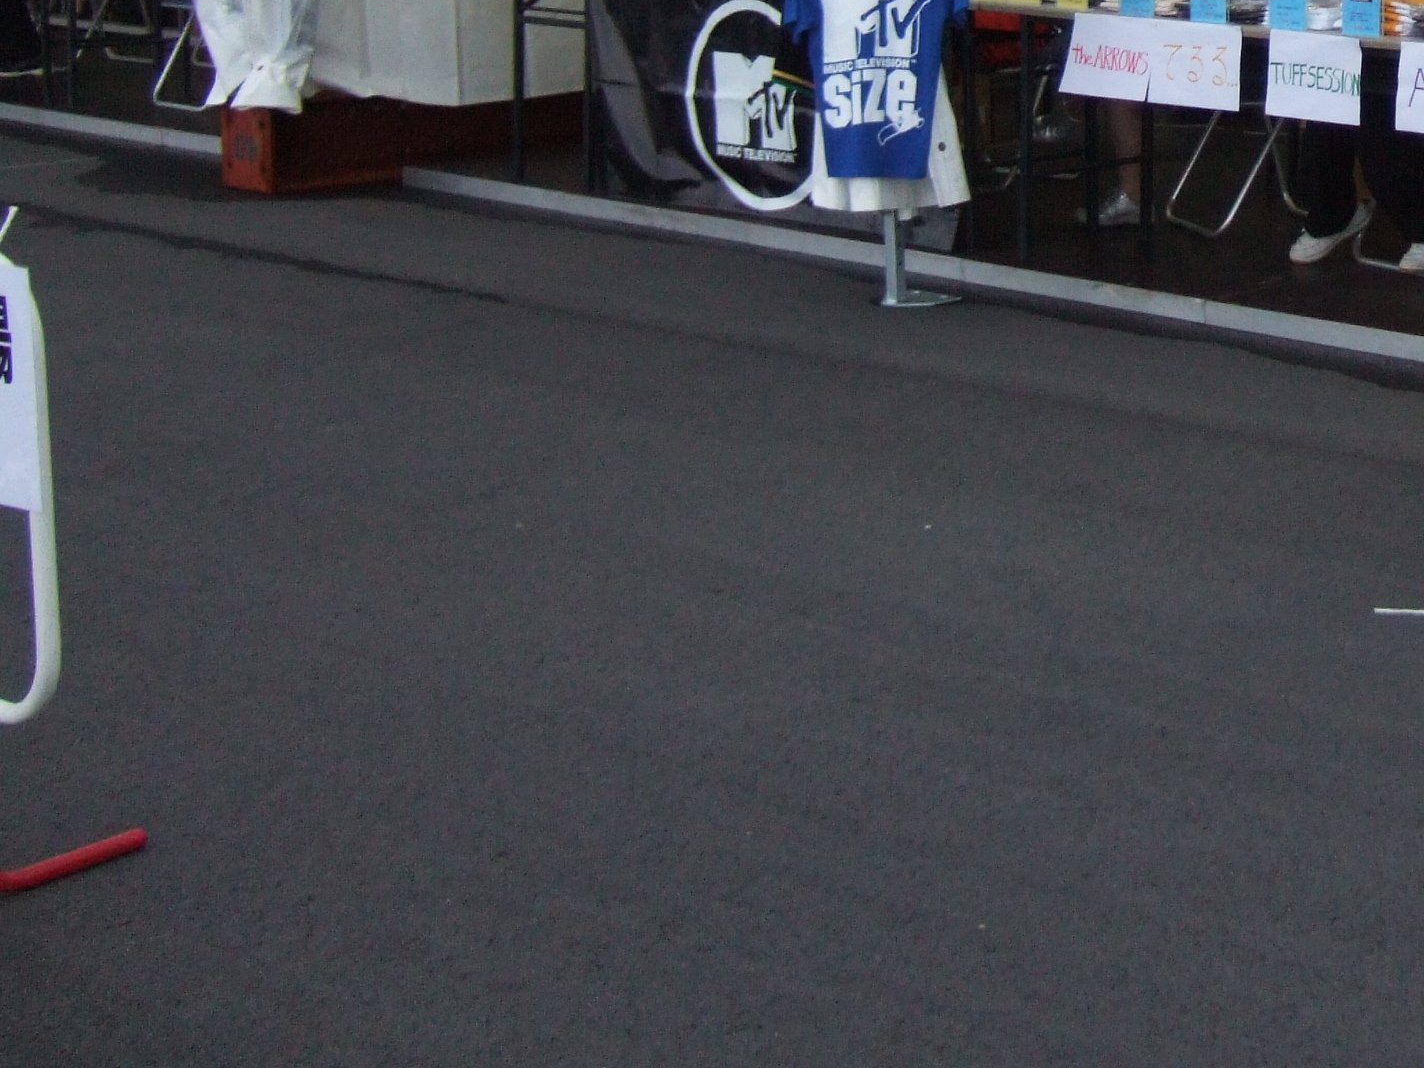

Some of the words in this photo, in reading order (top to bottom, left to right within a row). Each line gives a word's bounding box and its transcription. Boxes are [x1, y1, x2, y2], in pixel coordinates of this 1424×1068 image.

[823, 60, 854, 75] MUSIC
[855, 57, 911, 69] TELEVISION
[1270, 62, 1361, 97] TUFFSESSION
[713, 51, 797, 150] MTV
